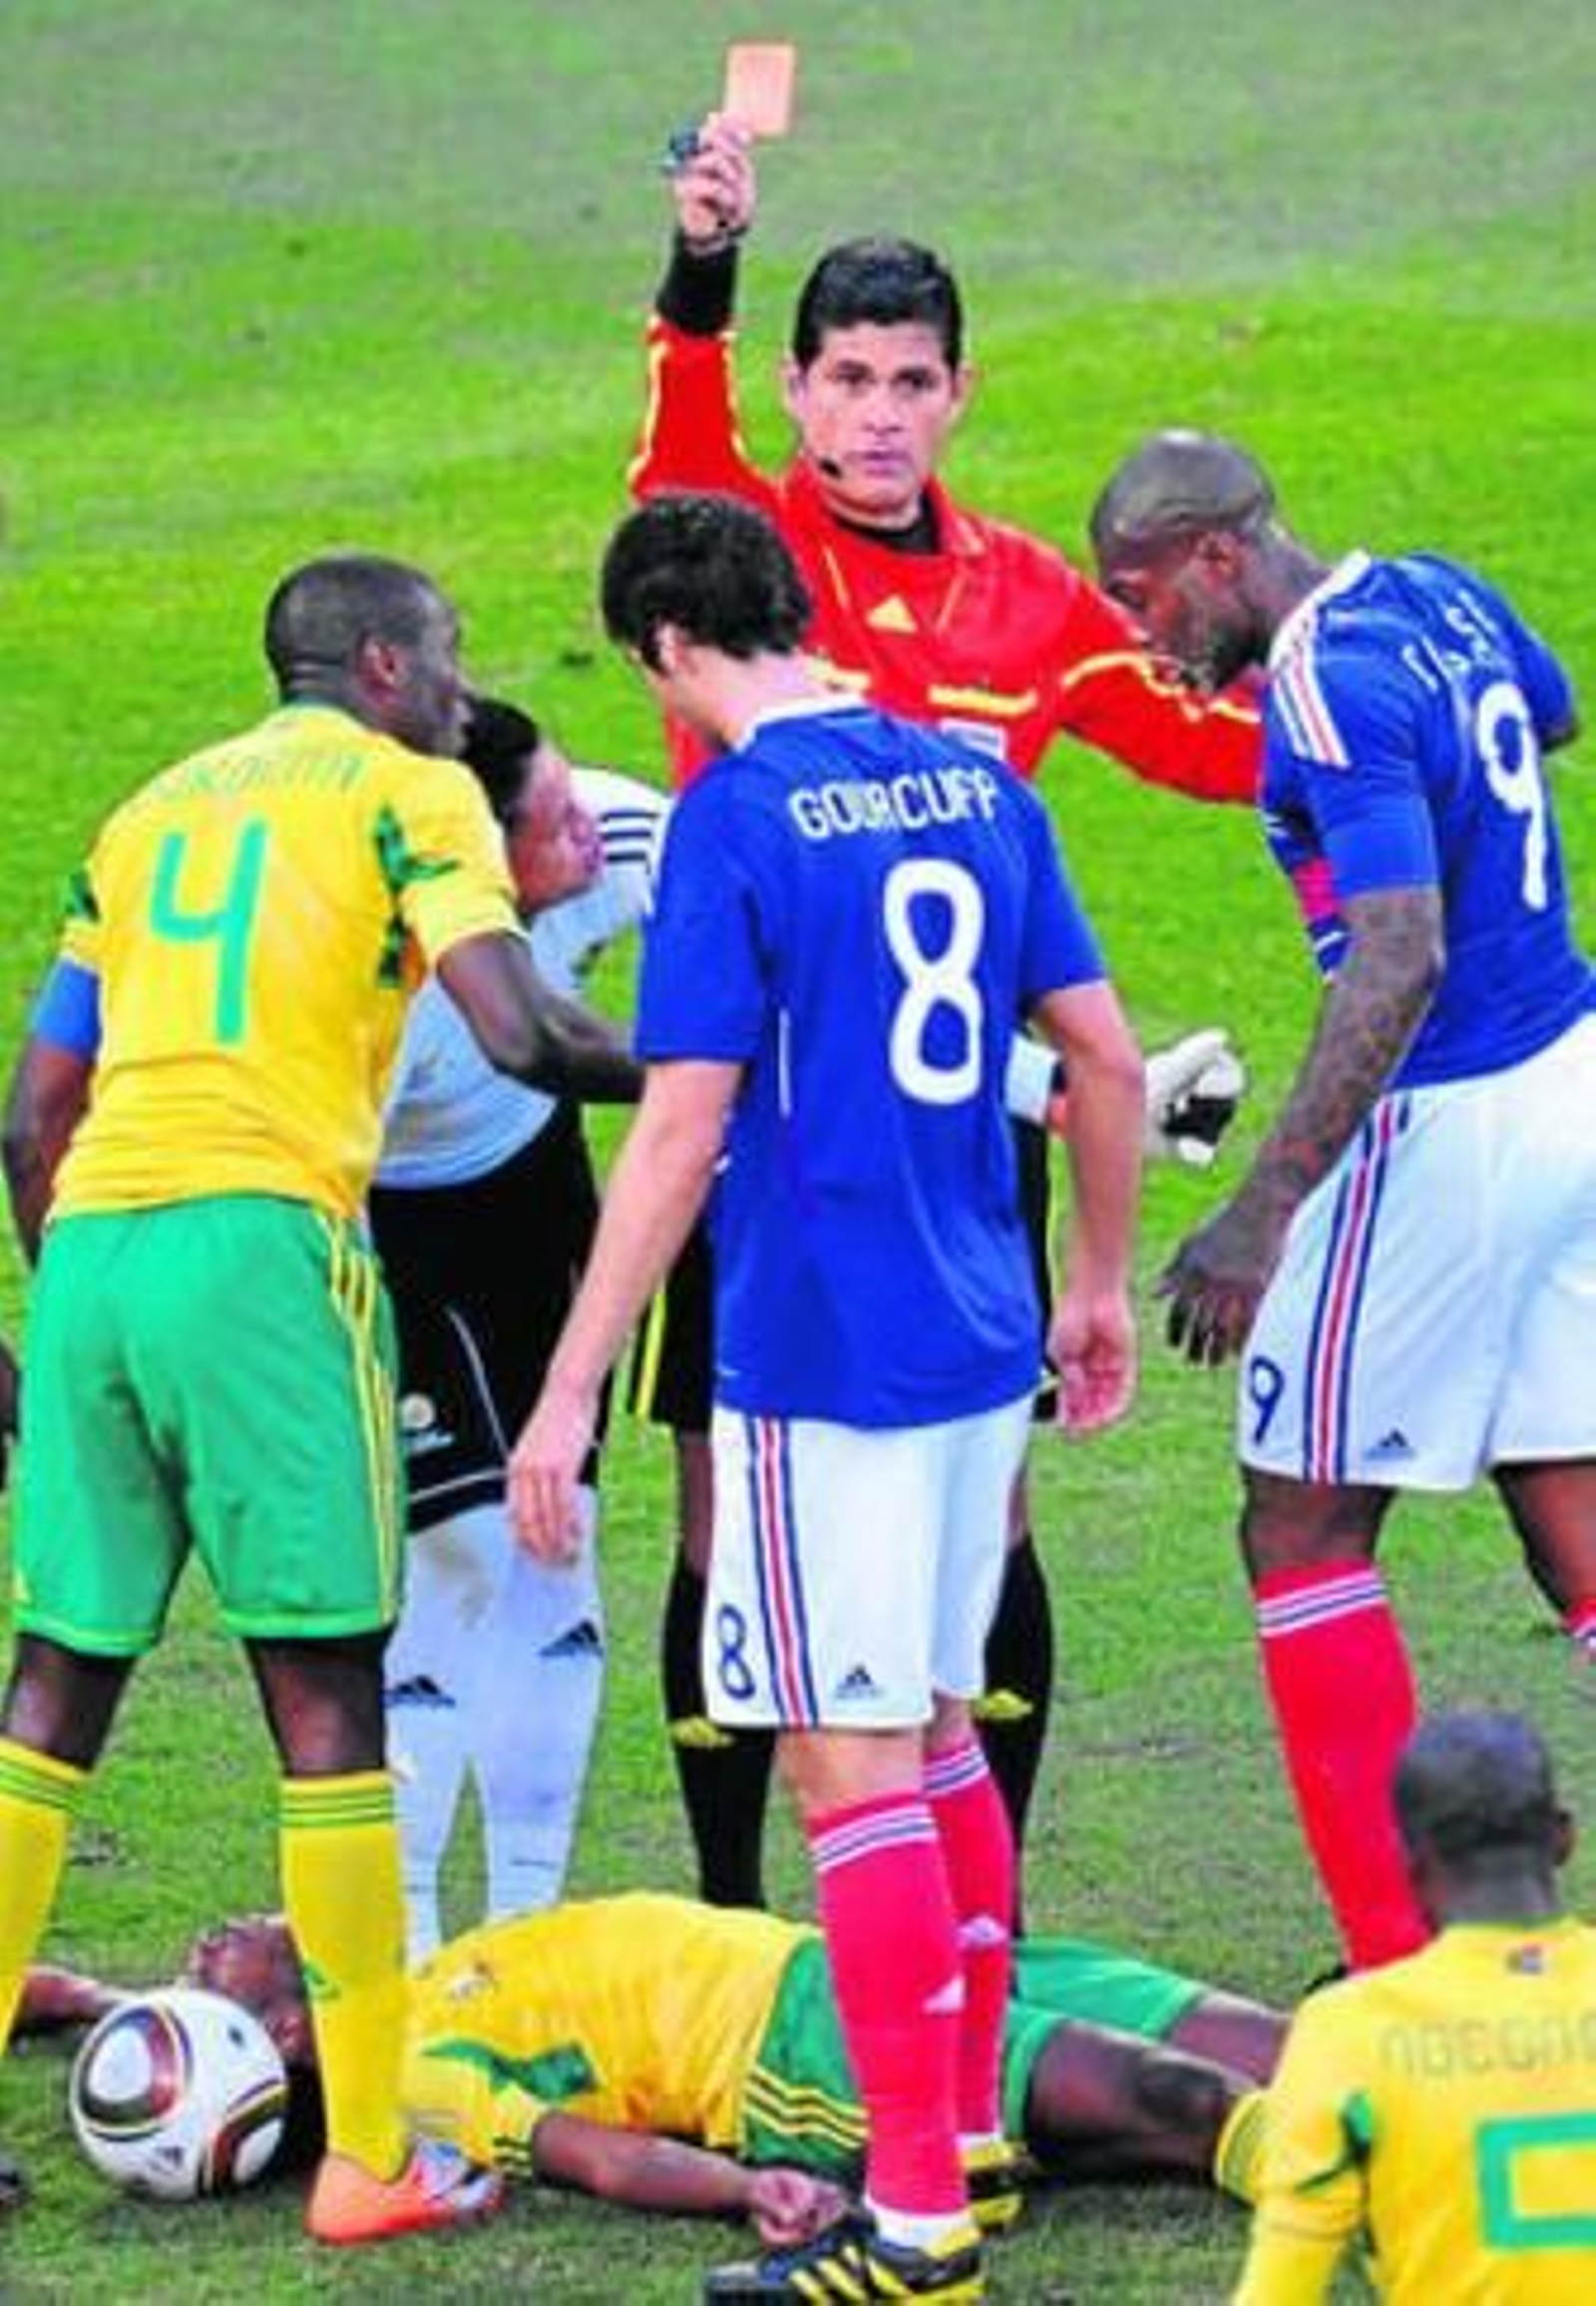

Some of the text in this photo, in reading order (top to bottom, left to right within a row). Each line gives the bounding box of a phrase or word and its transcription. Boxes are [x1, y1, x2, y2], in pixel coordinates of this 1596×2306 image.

[790, 767, 998, 840] GOURCUFF
[1476, 682, 1547, 911] 9
[150, 821, 267, 1041] 4
[884, 859, 984, 1104] 8
[1250, 1355, 1285, 1445] 9
[718, 1603, 755, 1700] 8
